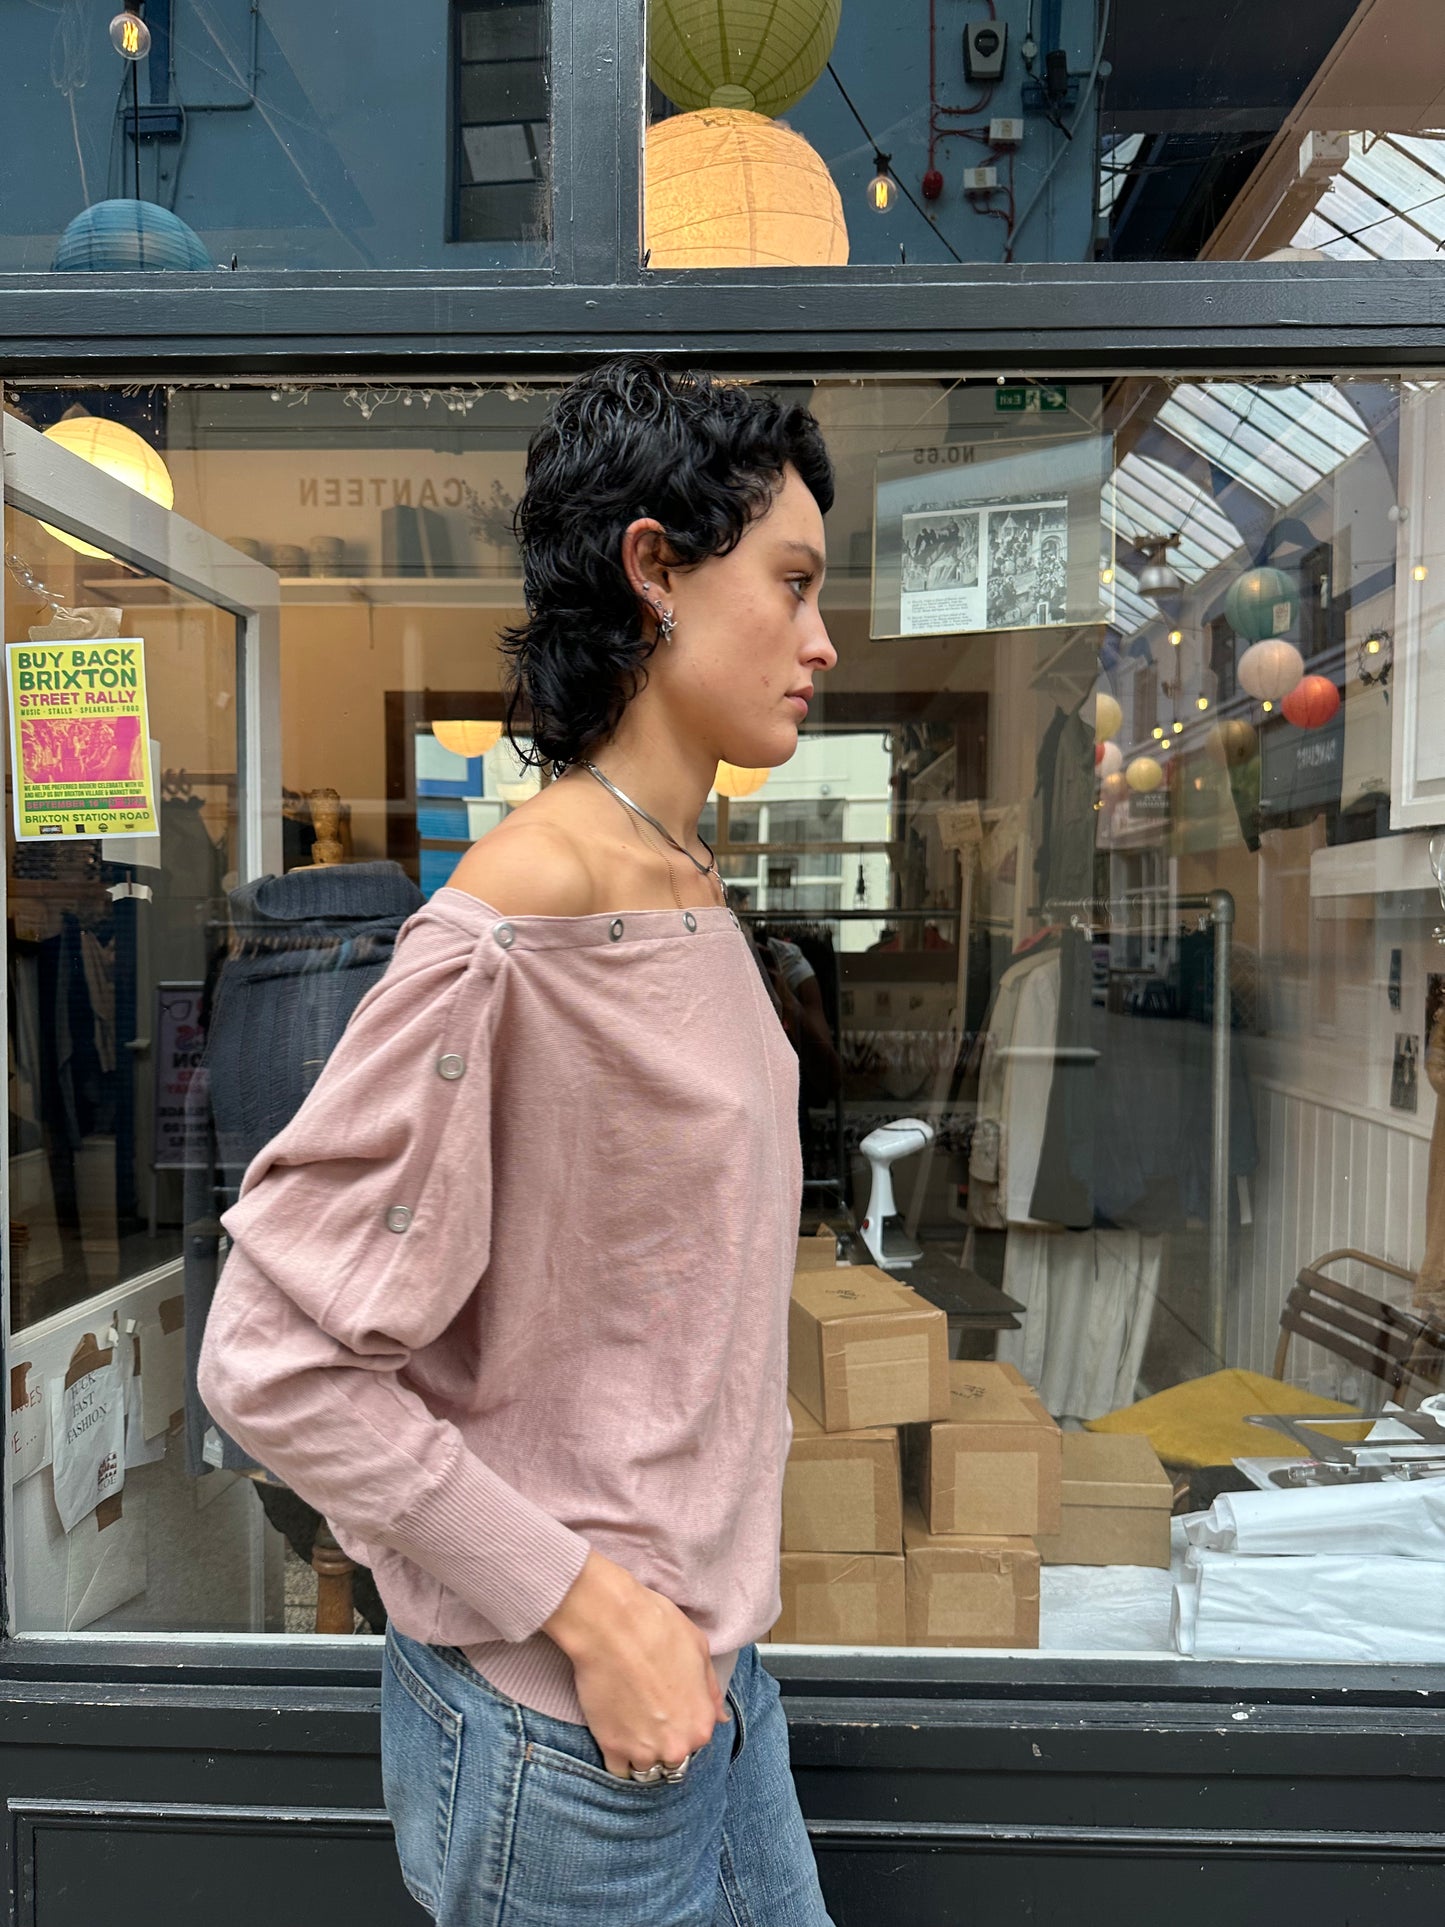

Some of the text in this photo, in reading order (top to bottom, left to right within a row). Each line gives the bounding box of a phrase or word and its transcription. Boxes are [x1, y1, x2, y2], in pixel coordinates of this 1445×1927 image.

[18, 648, 136, 669] BUY BACK
[19, 667, 137, 691] BRIXTON
[19, 690, 136, 707] STREET RALLY
[20, 704, 140, 716] MUSIC STALLS SPEAKERS FOOD
[26, 800, 85, 809] SEPTEMBER
[25, 811, 150, 823] BRIXTON STATION ROAD
[71, 1391, 97, 1418] FAST
[66, 1402, 108, 1445] FASHION
